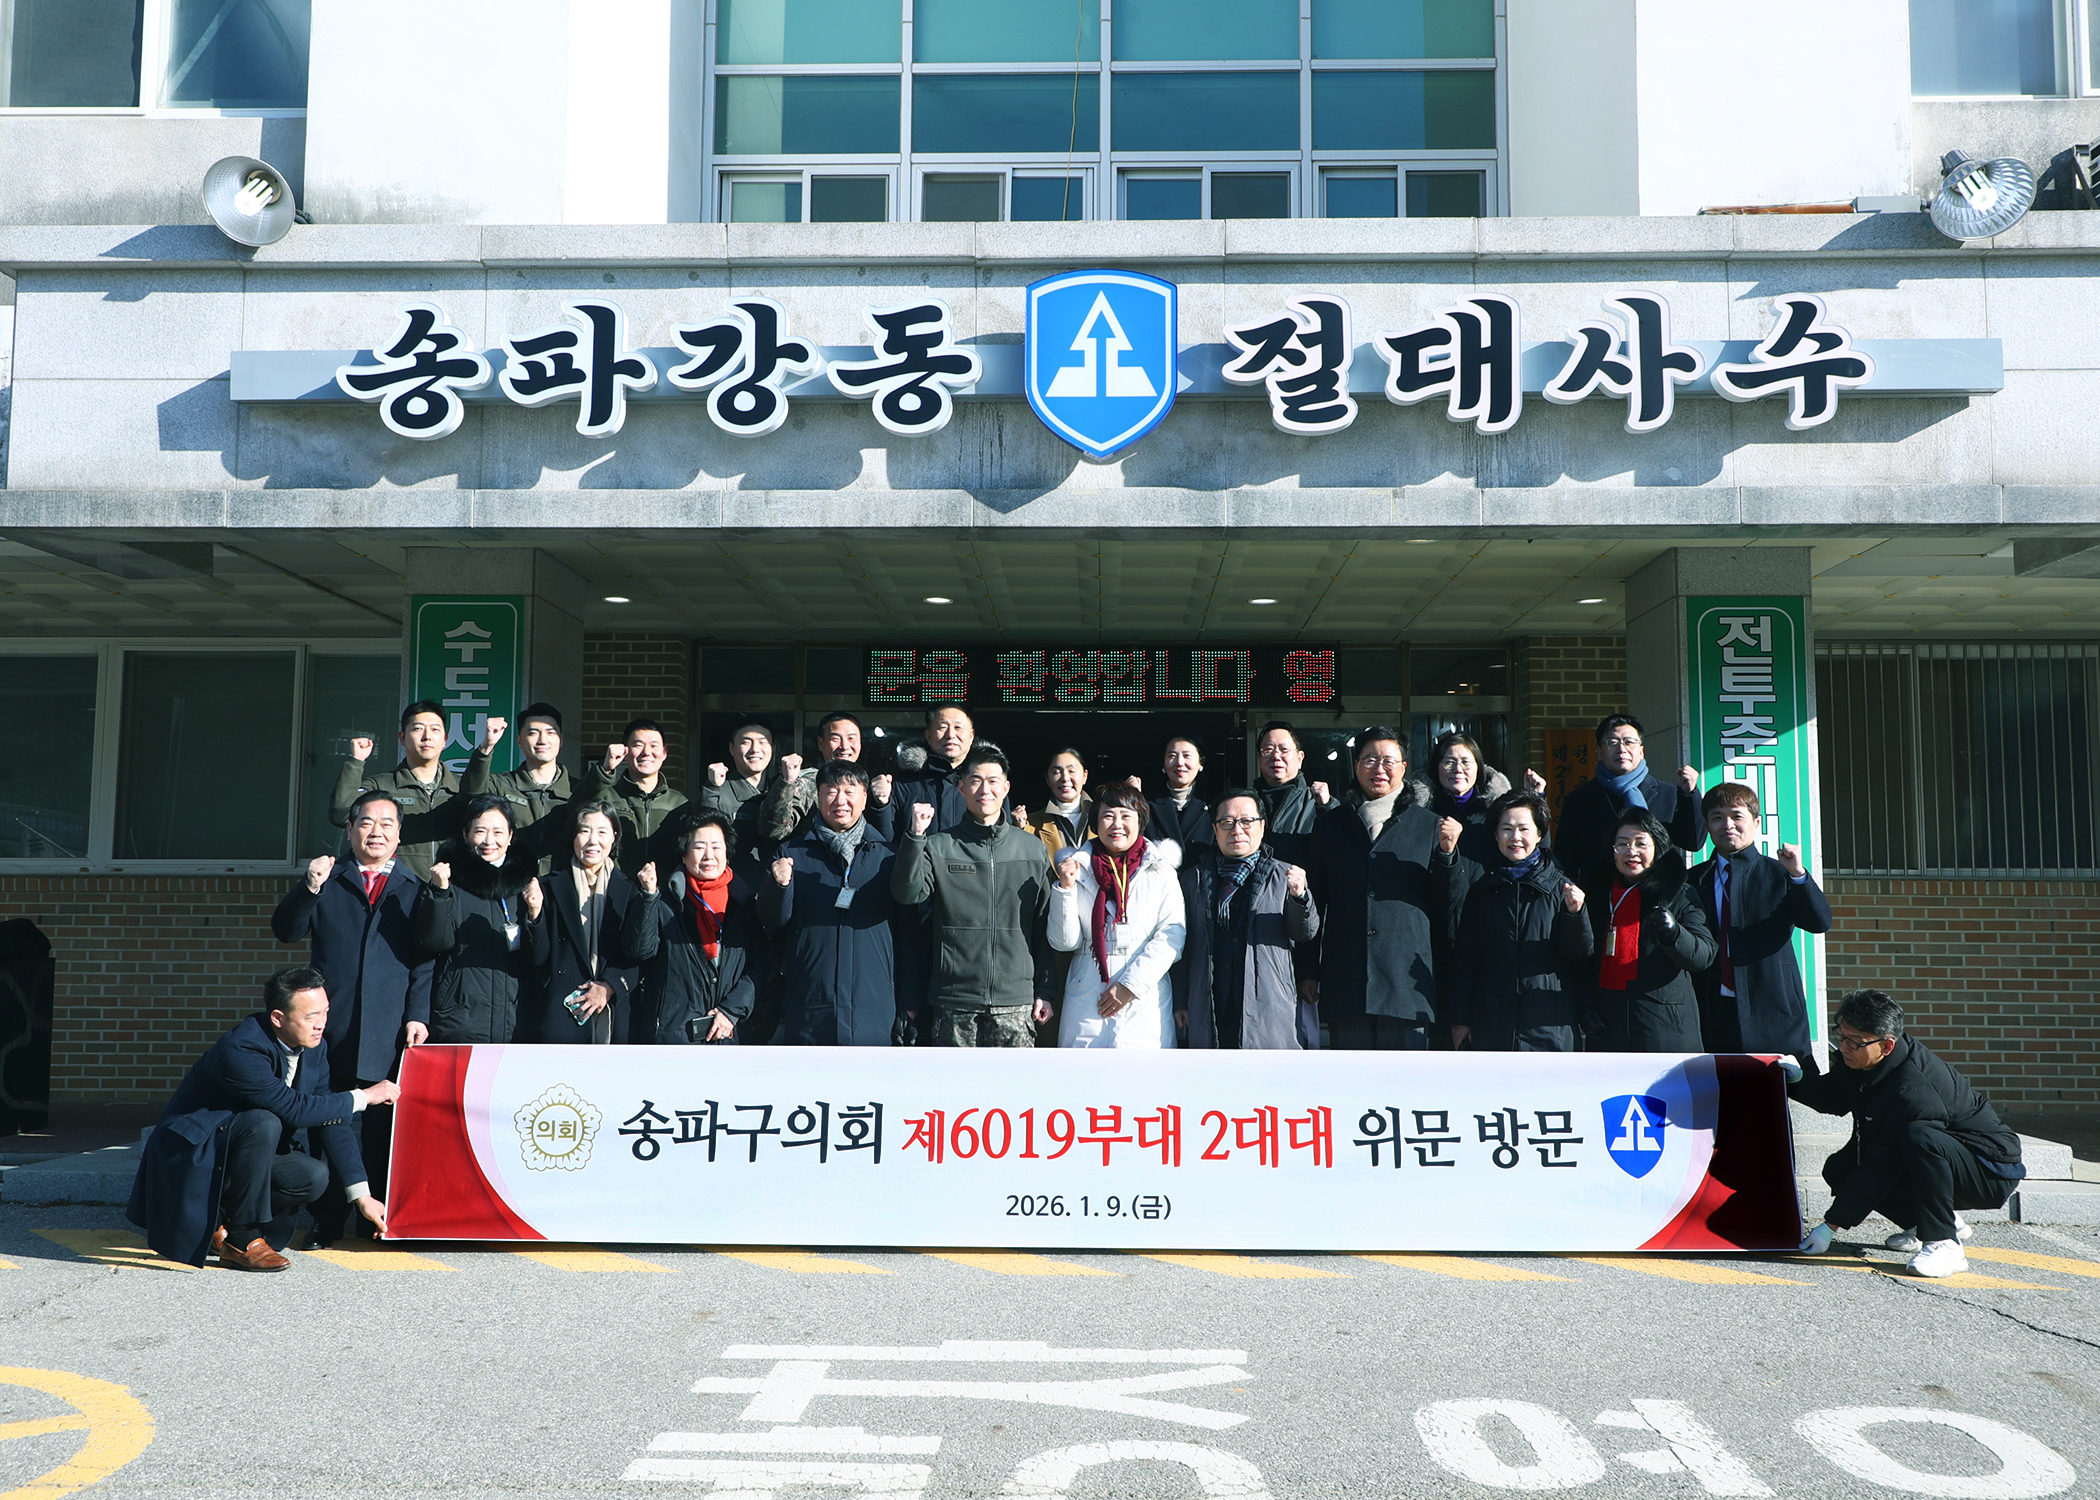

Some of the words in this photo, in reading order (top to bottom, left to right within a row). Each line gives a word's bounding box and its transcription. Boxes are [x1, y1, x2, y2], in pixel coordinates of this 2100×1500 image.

[343, 300, 976, 431] 송파강동
[1230, 296, 1870, 427] 절대사수
[867, 649, 971, 703] 문을
[996, 649, 1257, 703] 환영합니다
[536, 1119, 578, 1142] 의회
[617, 1099, 886, 1165] 송파구의회
[901, 1104, 1182, 1168] 제6019부대
[1200, 1105, 1334, 1168] 2대대
[1352, 1105, 1462, 1169] 위문
[1473, 1107, 1584, 1169] 방문
[1005, 1194, 1072, 1217] 2026.
[1080, 1195, 1100, 1217] 1.
